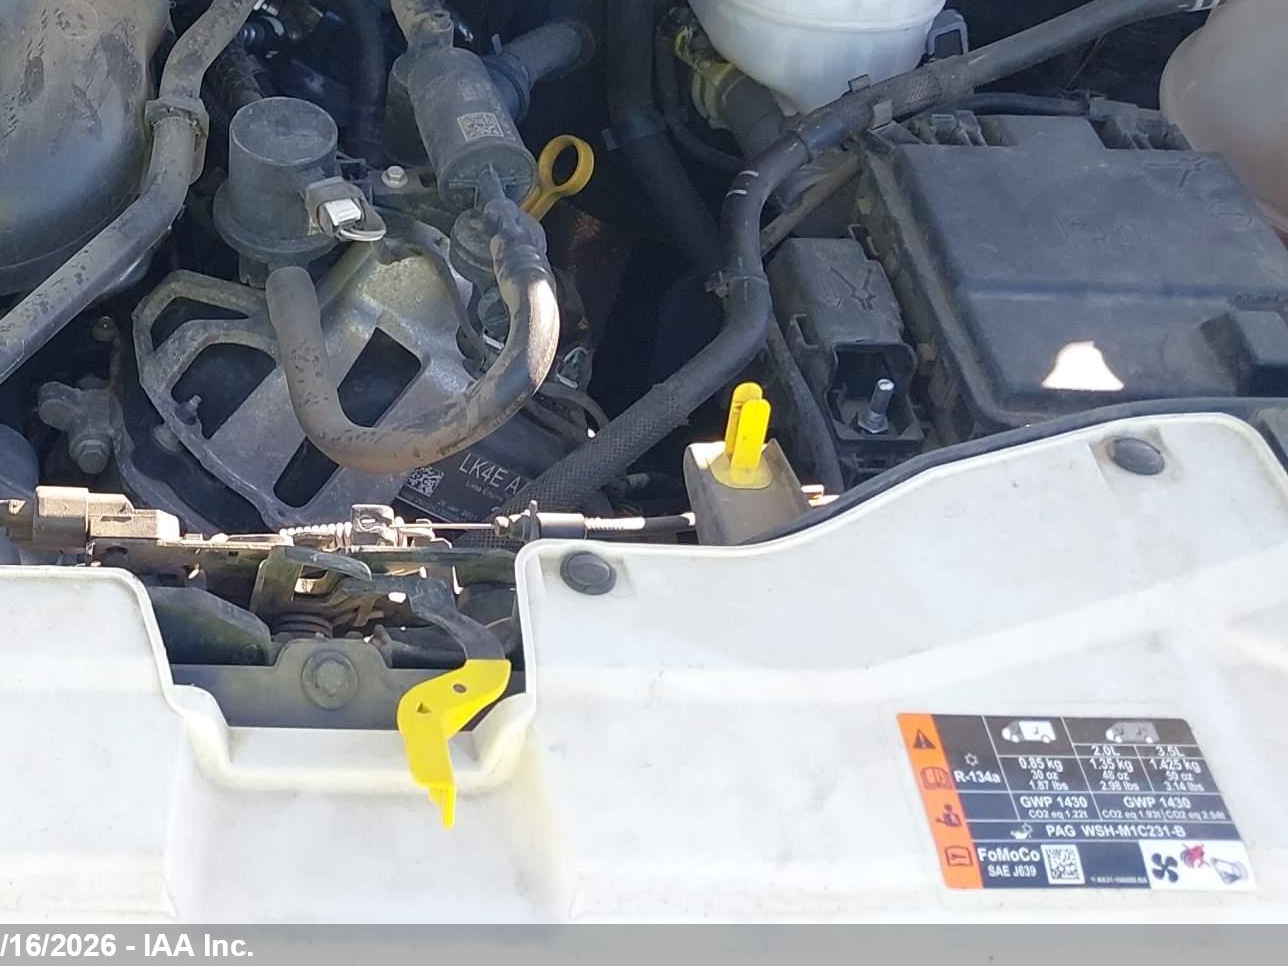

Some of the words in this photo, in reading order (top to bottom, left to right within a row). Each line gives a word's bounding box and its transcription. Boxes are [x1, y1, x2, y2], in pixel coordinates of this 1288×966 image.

[459, 454, 508, 488] LK4E
[1091, 745, 1120, 756] 2.0L
[1155, 745, 1184, 757] 3.5L
[1018, 757, 1044, 769] 0.85
[1046, 757, 1063, 772] kg
[1089, 758, 1116, 770] 1.35
[1118, 758, 1133, 773] kg
[1149, 758, 1182, 770] 1.425
[1184, 759, 1201, 773] kg
[954, 770, 1001, 783] R-134a
[1031, 769, 1042, 780] 30
[1046, 771, 1059, 780] oz
[1117, 772, 1129, 780] oz
[1051, 780, 1069, 791] lbs
[1124, 781, 1140, 791] lbs
[1163, 781, 1185, 791] 3.14
[1020, 796, 1052, 808] GWP
[1057, 796, 1088, 808] 1430
[1123, 796, 1156, 808] GWP
[1159, 797, 1191, 809] 1430
[1028, 810, 1049, 819] CO2
[1051, 811, 1063, 821] eq
[1102, 810, 1122, 819] CO2
[1124, 811, 1137, 821] eq
[1165, 810, 1186, 819] CO2
[1188, 812, 1202, 821] eq
[1045, 825, 1076, 837] PAG
[1081, 825, 1187, 837] WSH-M1C231-B
[977, 847, 1041, 862] FoMoCo
[987, 865, 1010, 877] SAE
